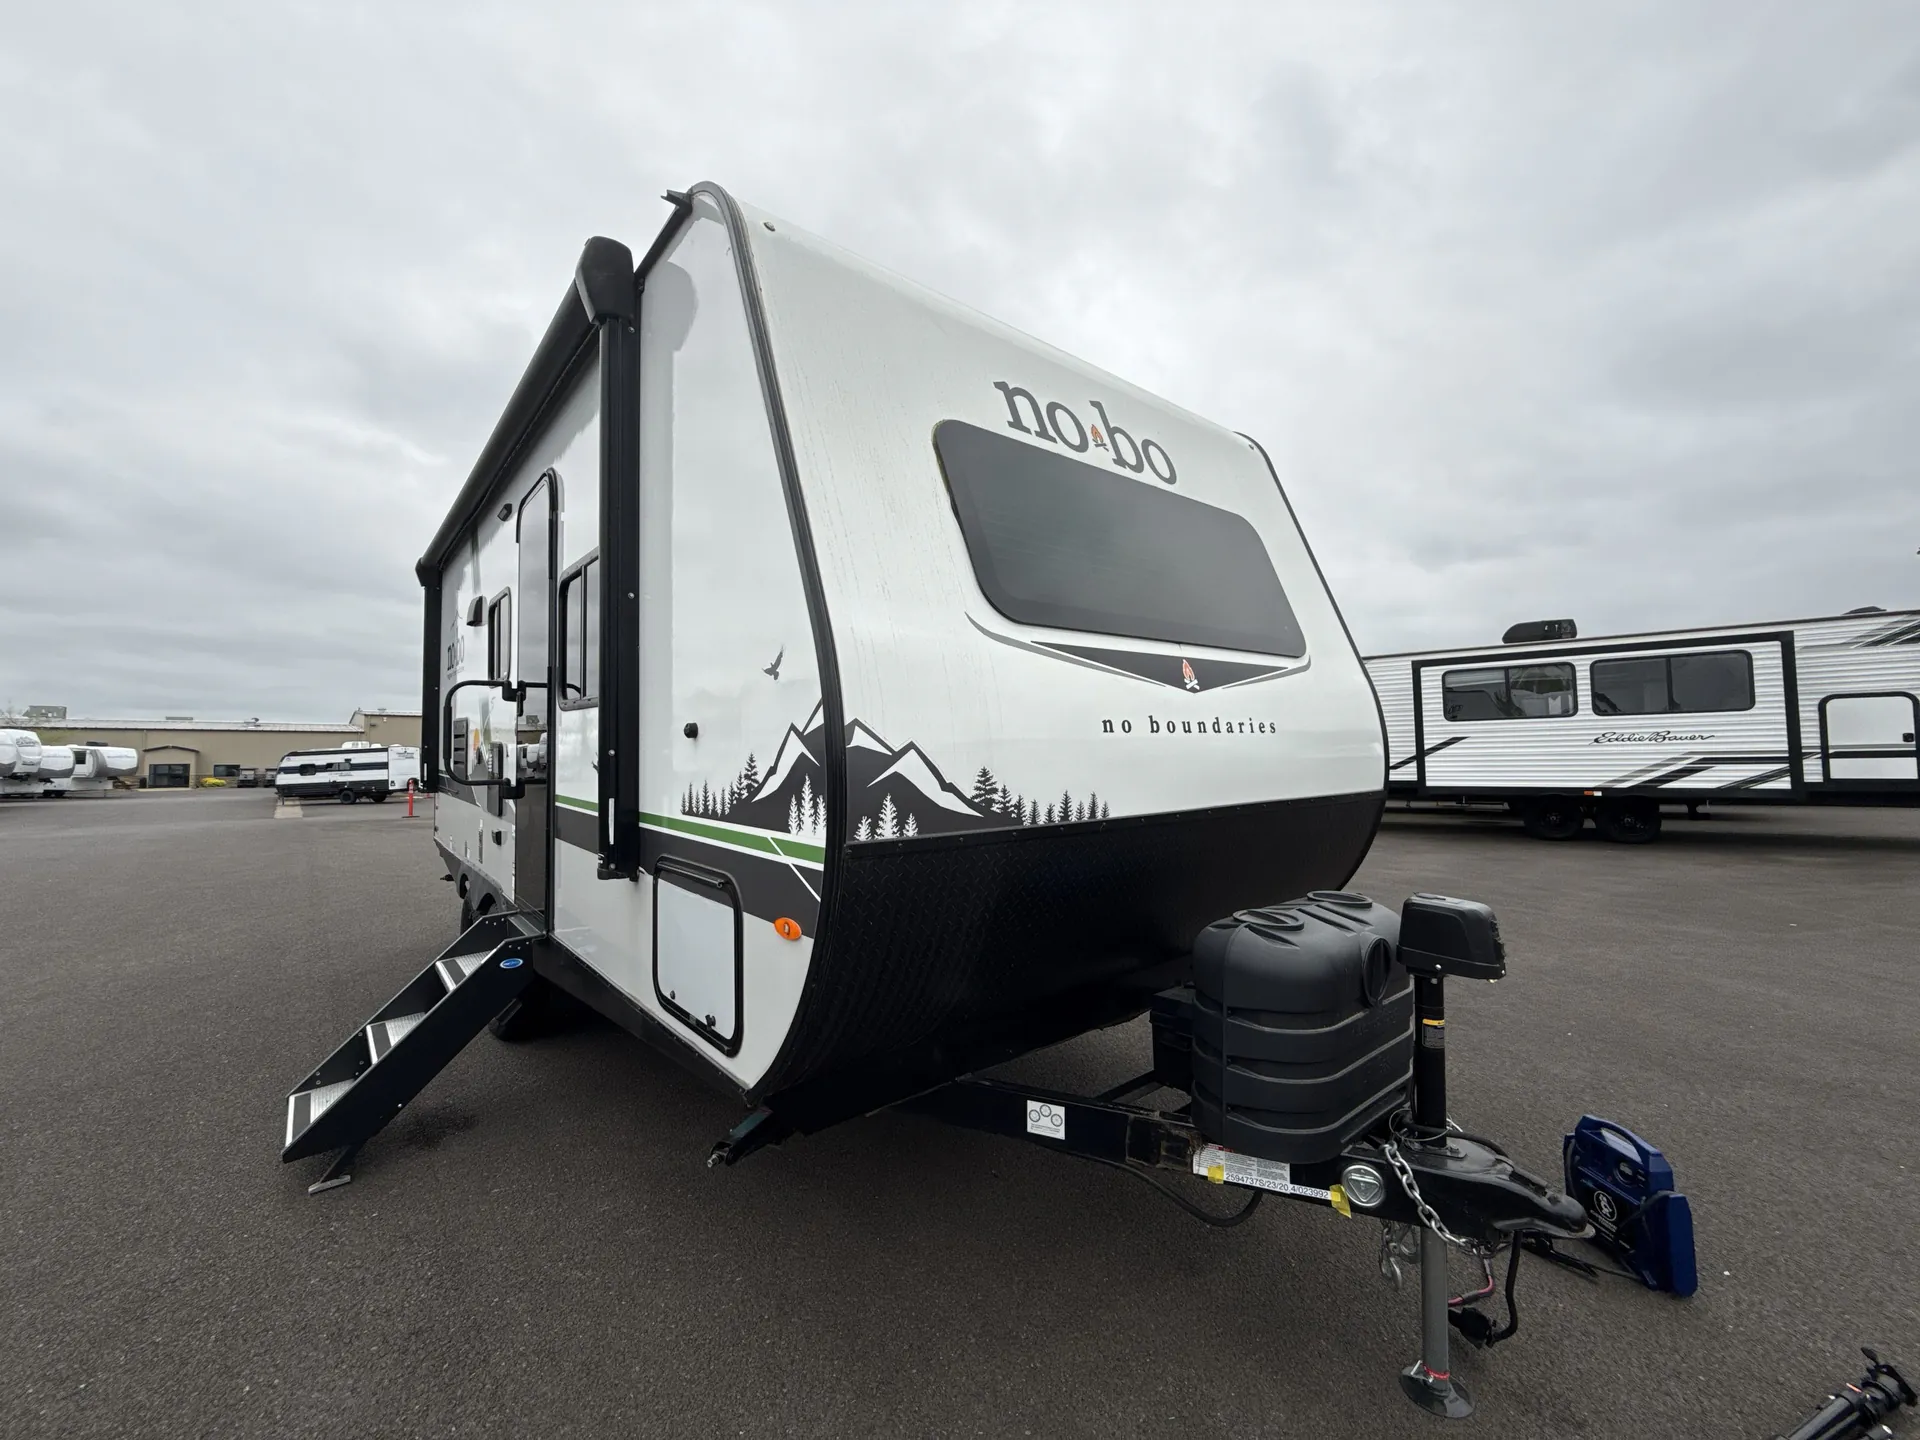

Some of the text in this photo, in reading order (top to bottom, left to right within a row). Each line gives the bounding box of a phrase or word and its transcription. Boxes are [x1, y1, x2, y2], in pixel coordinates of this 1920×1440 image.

[1102, 715, 1277, 734] no boundaries
[1589, 730, 1715, 745] Eddie Bauer
